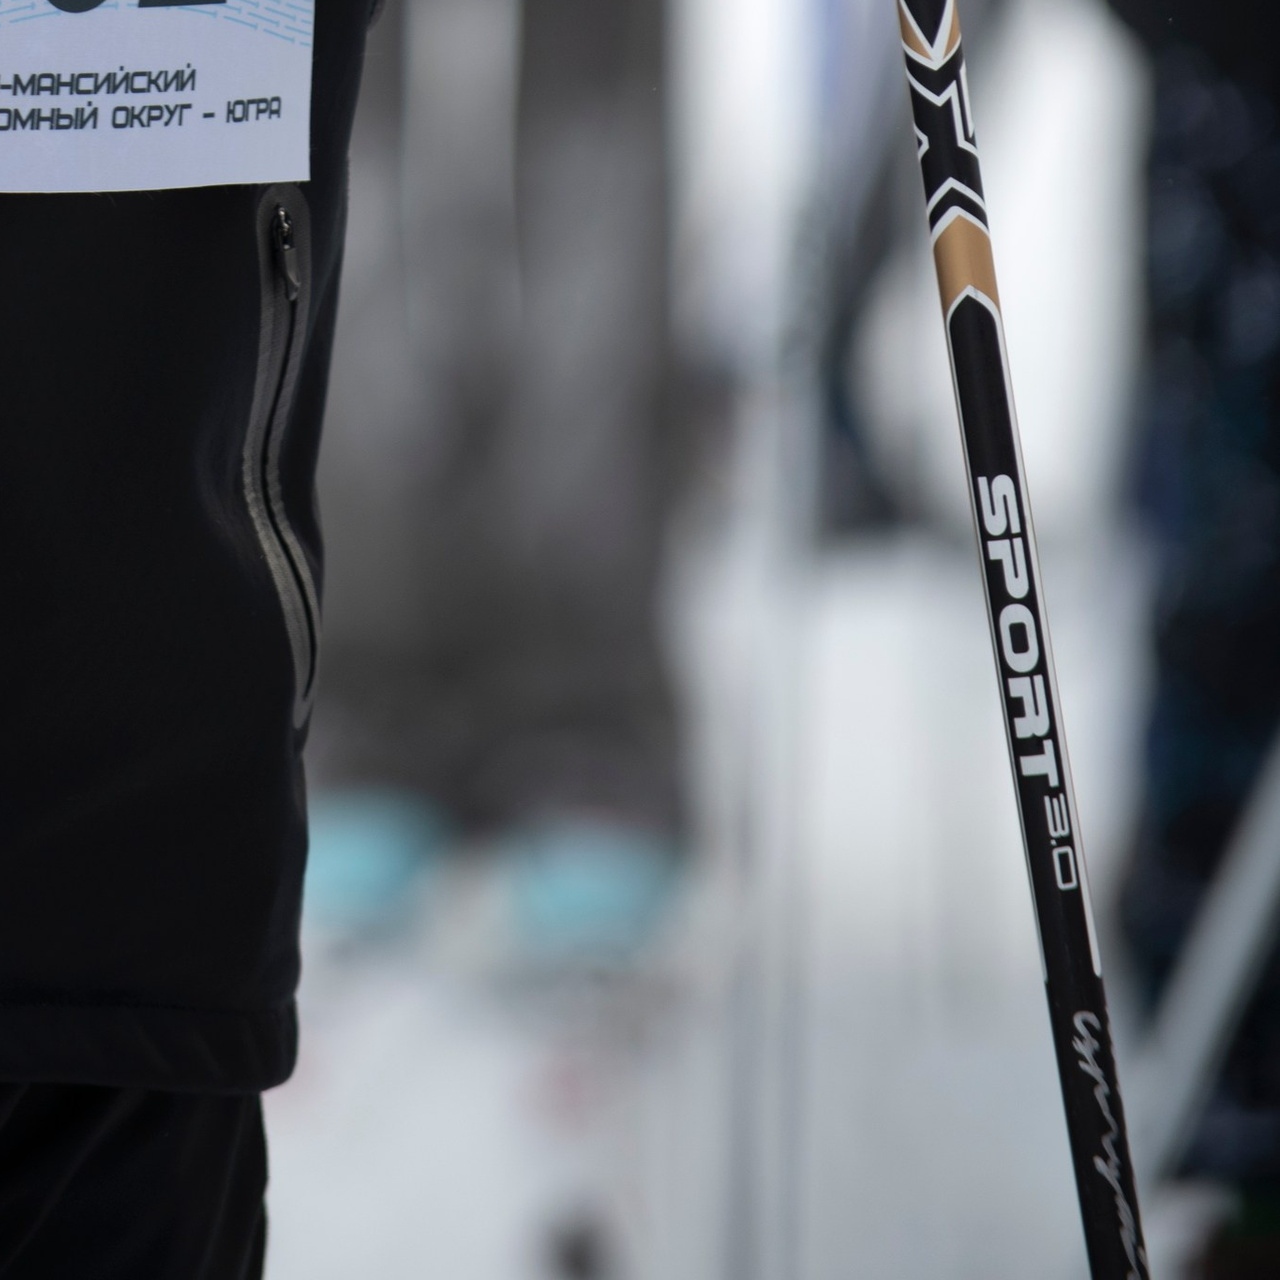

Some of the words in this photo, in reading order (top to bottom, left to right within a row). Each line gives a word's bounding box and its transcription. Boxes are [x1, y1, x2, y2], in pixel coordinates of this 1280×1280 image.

[111, 103, 192, 130] ОКРУГ
[225, 96, 283, 124] ЮГРА
[977, 473, 1060, 788] SPORT
[1043, 792, 1078, 892] 3.0
